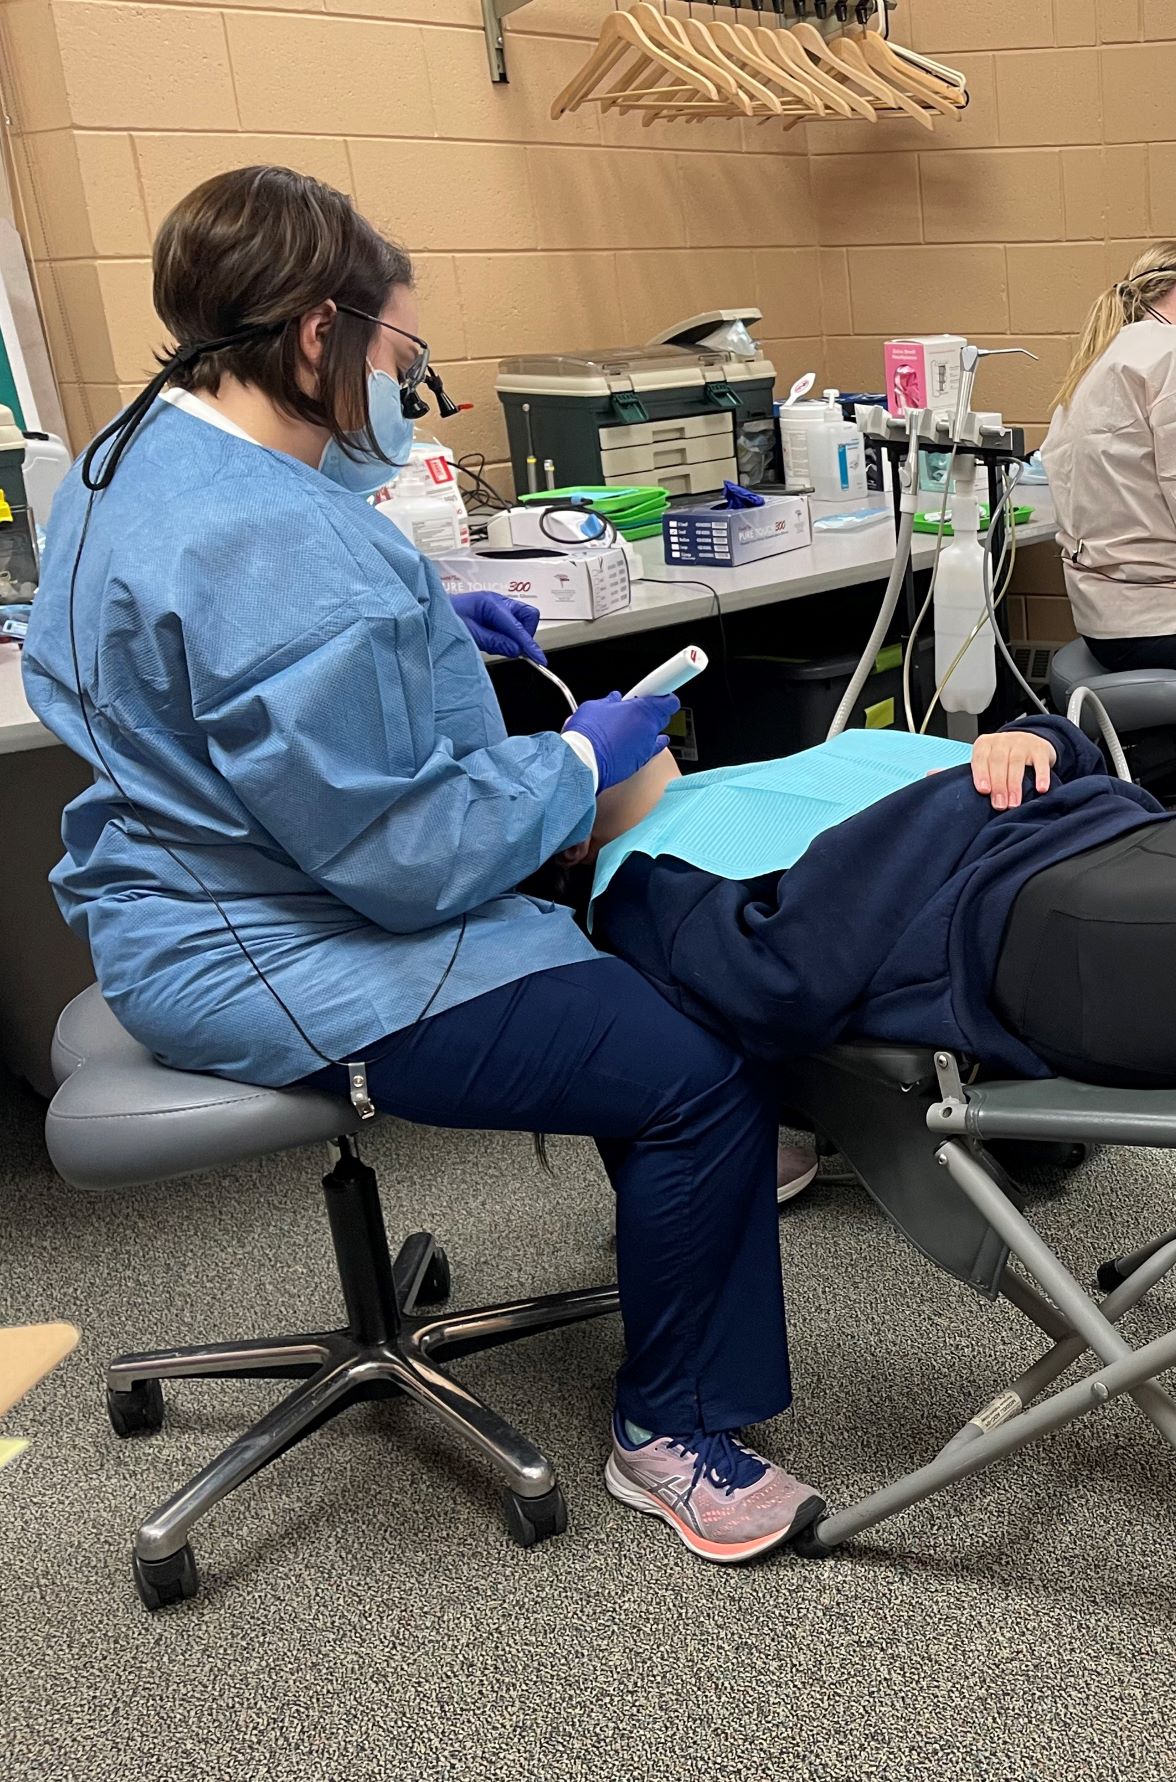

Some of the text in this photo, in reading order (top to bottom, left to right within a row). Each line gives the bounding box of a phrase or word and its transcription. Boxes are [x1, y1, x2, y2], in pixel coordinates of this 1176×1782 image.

[738, 530, 754, 542] PURE
[775, 520, 786, 532] 300
[441, 582, 465, 592] URE
[508, 581, 531, 592] 300
